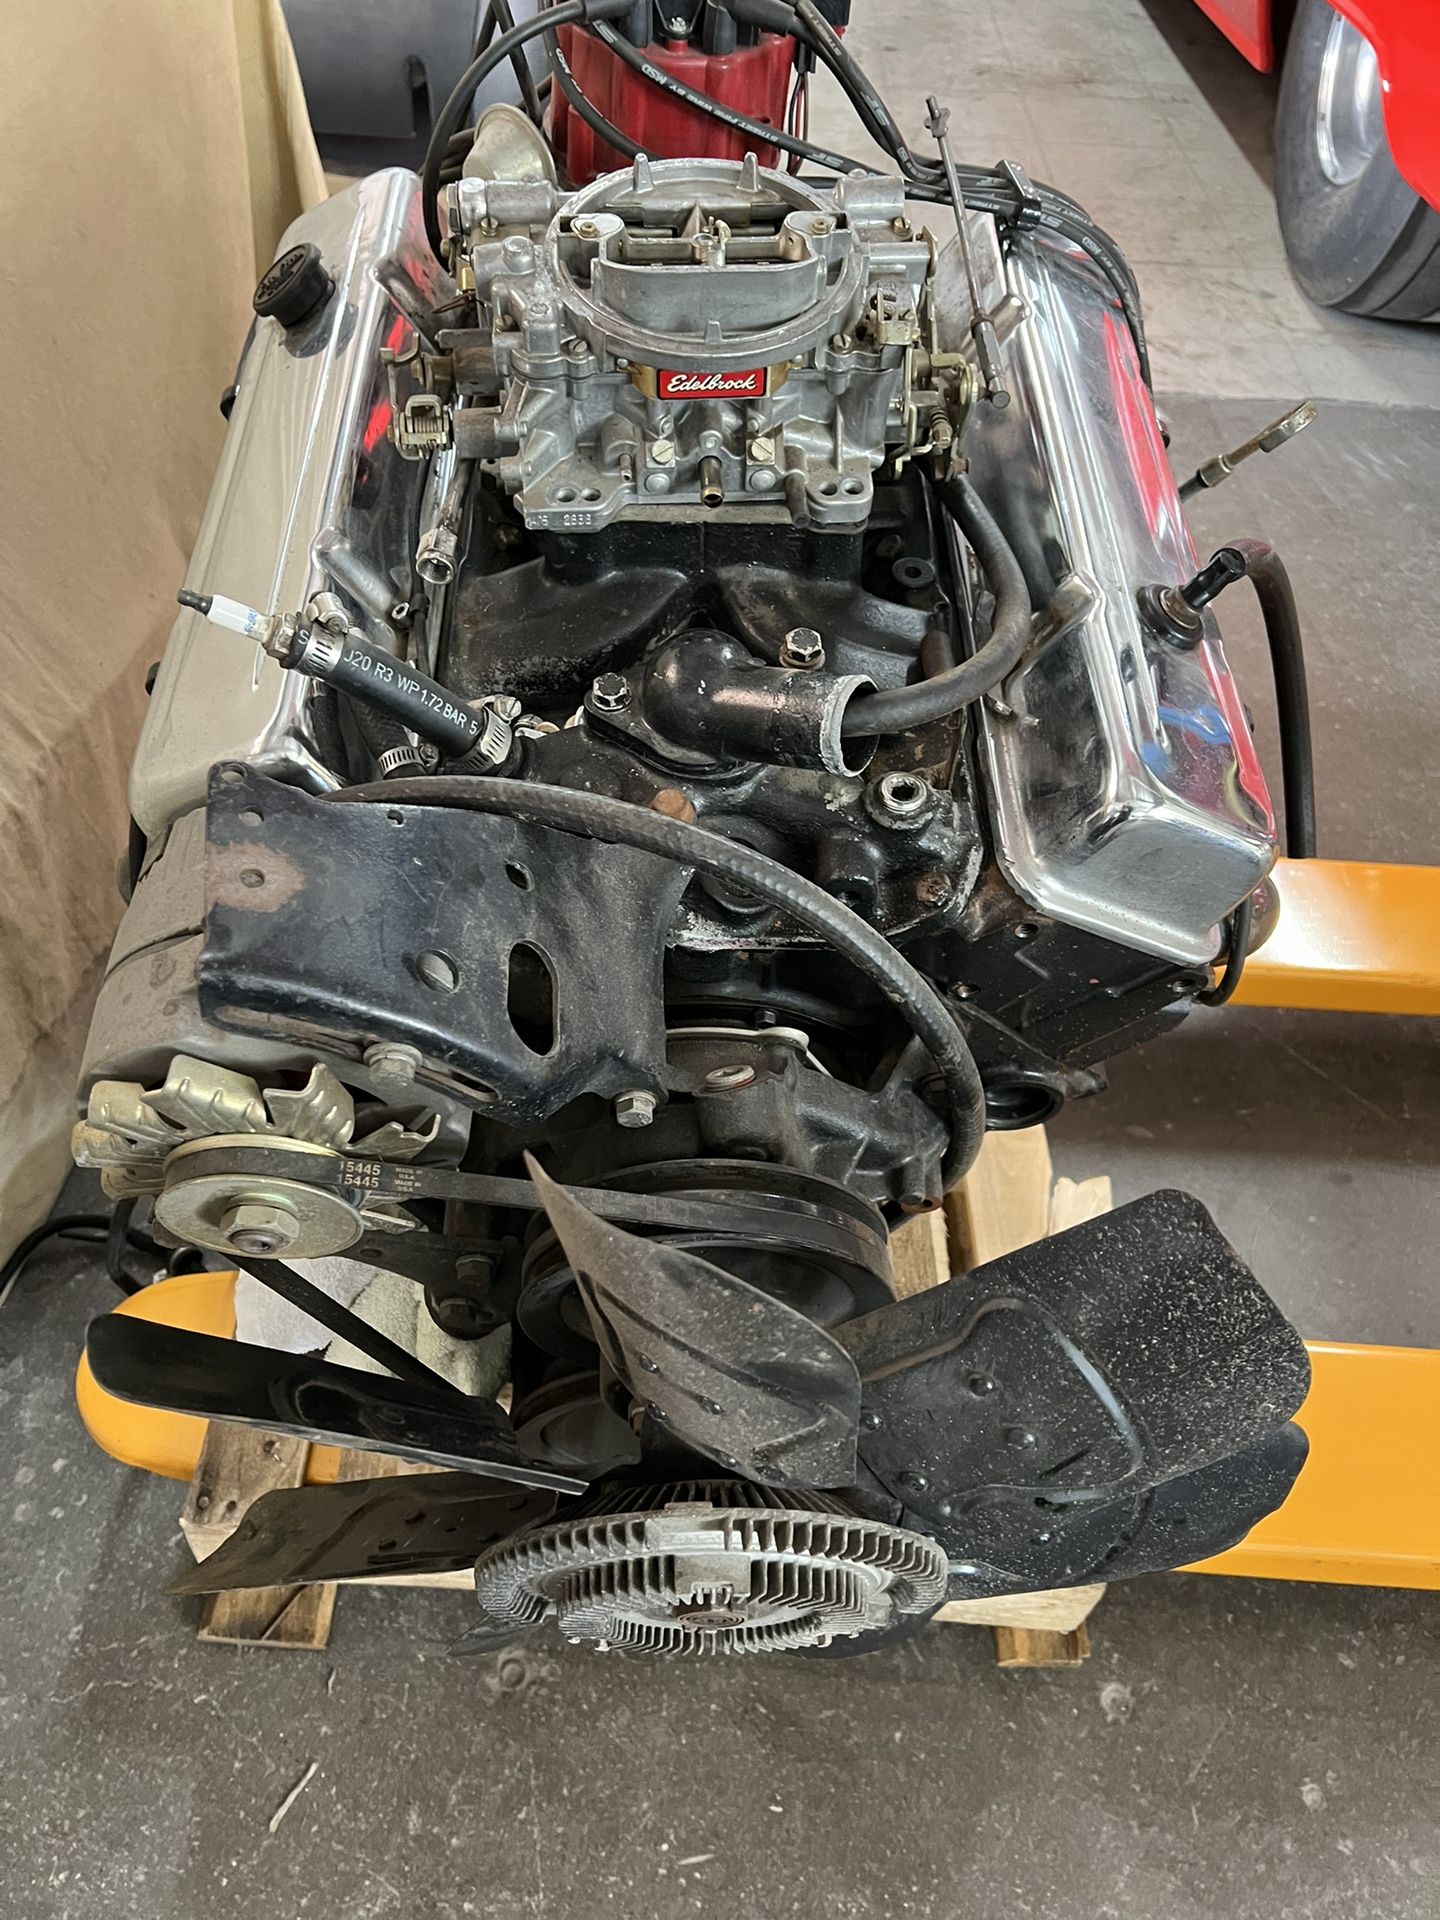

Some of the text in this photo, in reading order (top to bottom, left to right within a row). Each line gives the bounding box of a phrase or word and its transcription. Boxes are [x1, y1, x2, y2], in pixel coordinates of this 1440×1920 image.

[641, 63, 668, 85] MSD
[666, 373, 757, 393] Edelbrock
[343, 649, 372, 671] J20
[373, 661, 394, 682] R3
[397, 673, 420, 694] WP
[338, 1161, 381, 1176] 15445
[336, 1173, 380, 1188] 15445
